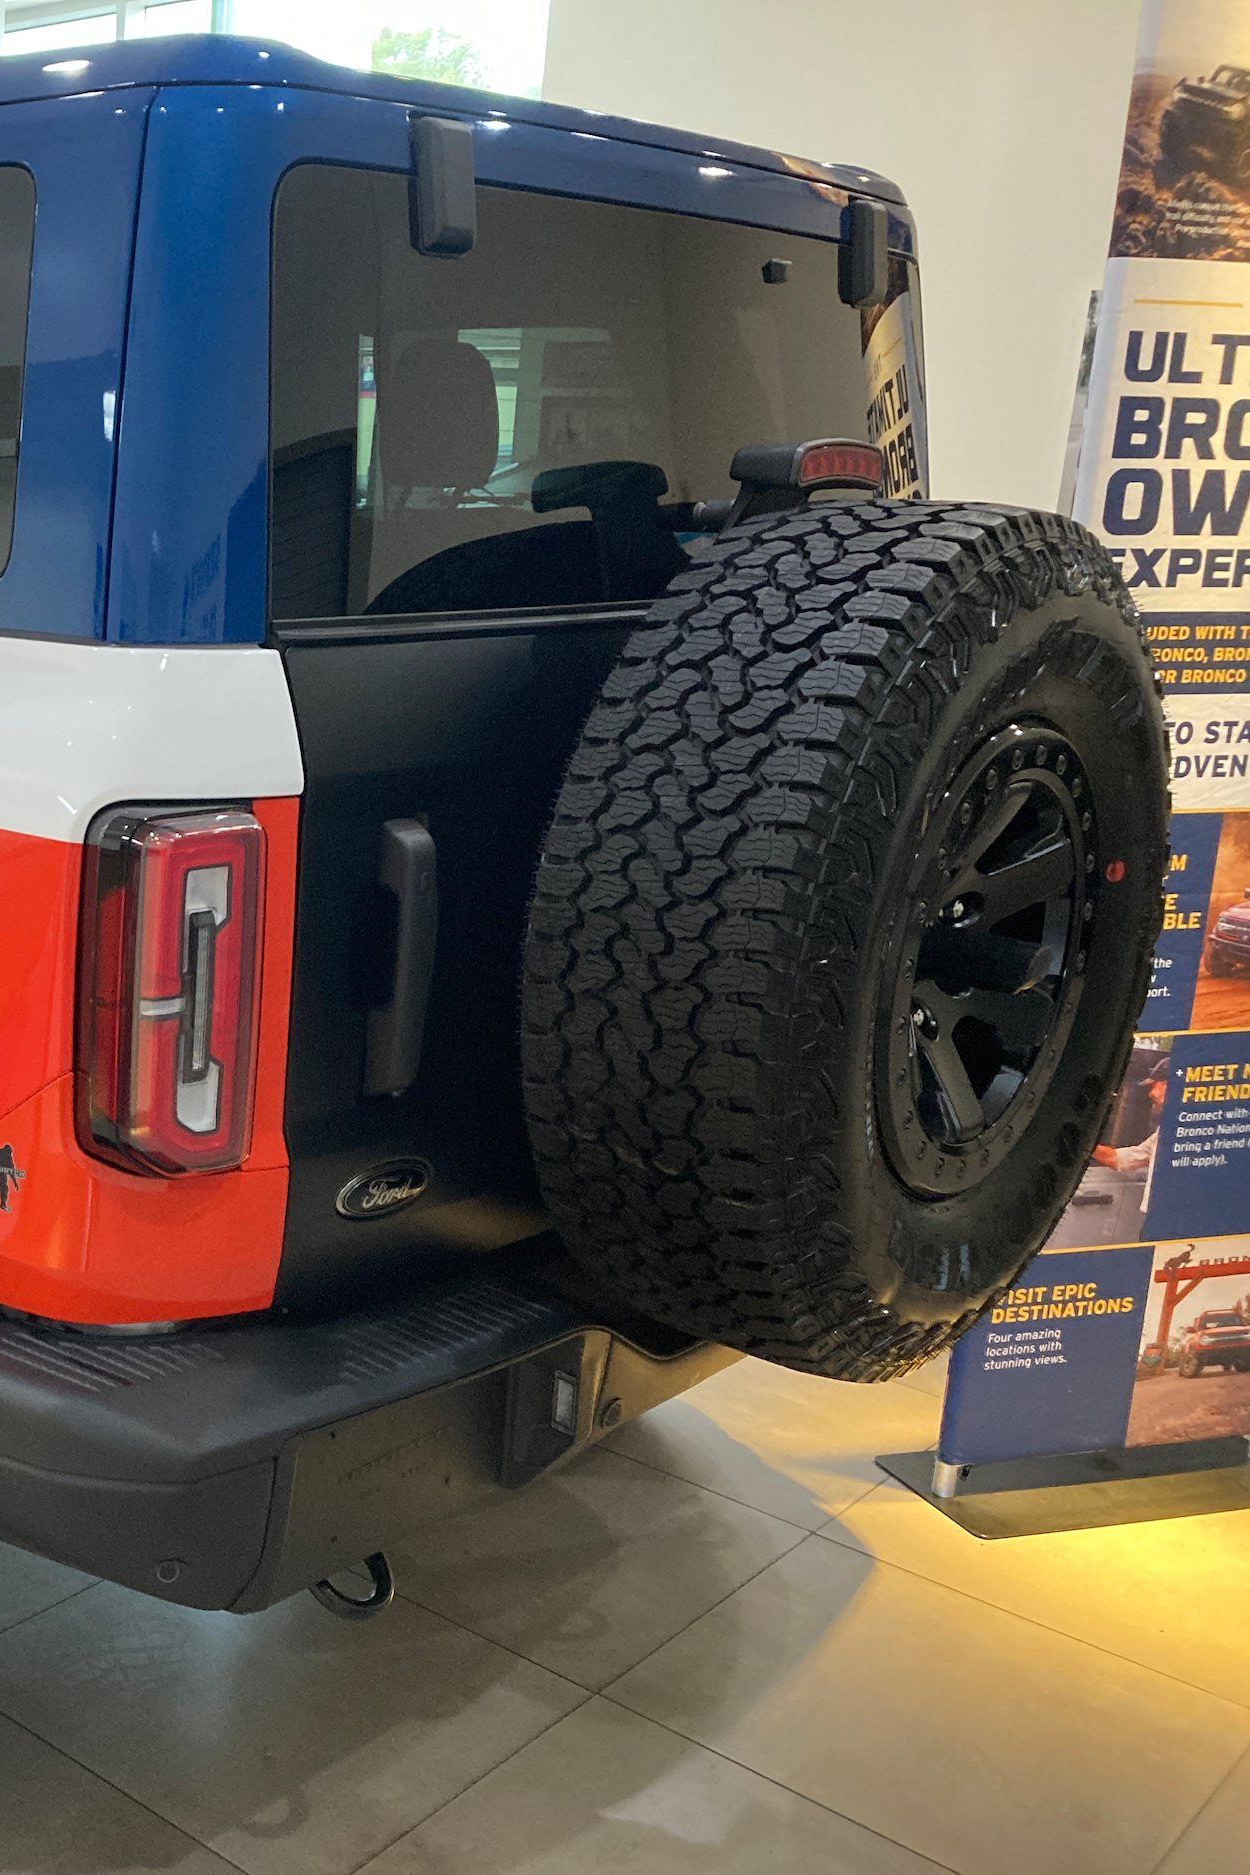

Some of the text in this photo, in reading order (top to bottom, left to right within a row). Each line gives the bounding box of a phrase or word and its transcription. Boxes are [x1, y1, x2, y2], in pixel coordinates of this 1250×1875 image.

[1195, 625, 1236, 640] WITH
[1181, 668, 1247, 684] BRONCO
[1185, 1063, 1239, 1083] MEET
[1178, 1108, 1249, 1122] Connect with
[1176, 1123, 1250, 1138] Bronco Nation
[1173, 1138, 1245, 1154] bring a friend
[1172, 1155, 1190, 1168] will
[361, 1177, 422, 1210] Ford
[1052, 1282, 1097, 1301] EPIC
[990, 1296, 1134, 1325] DESTINATIONS
[988, 1328, 1062, 1344] Four amazing
[986, 1340, 1062, 1357] locations with
[984, 1353, 1068, 1371] stunning views.
